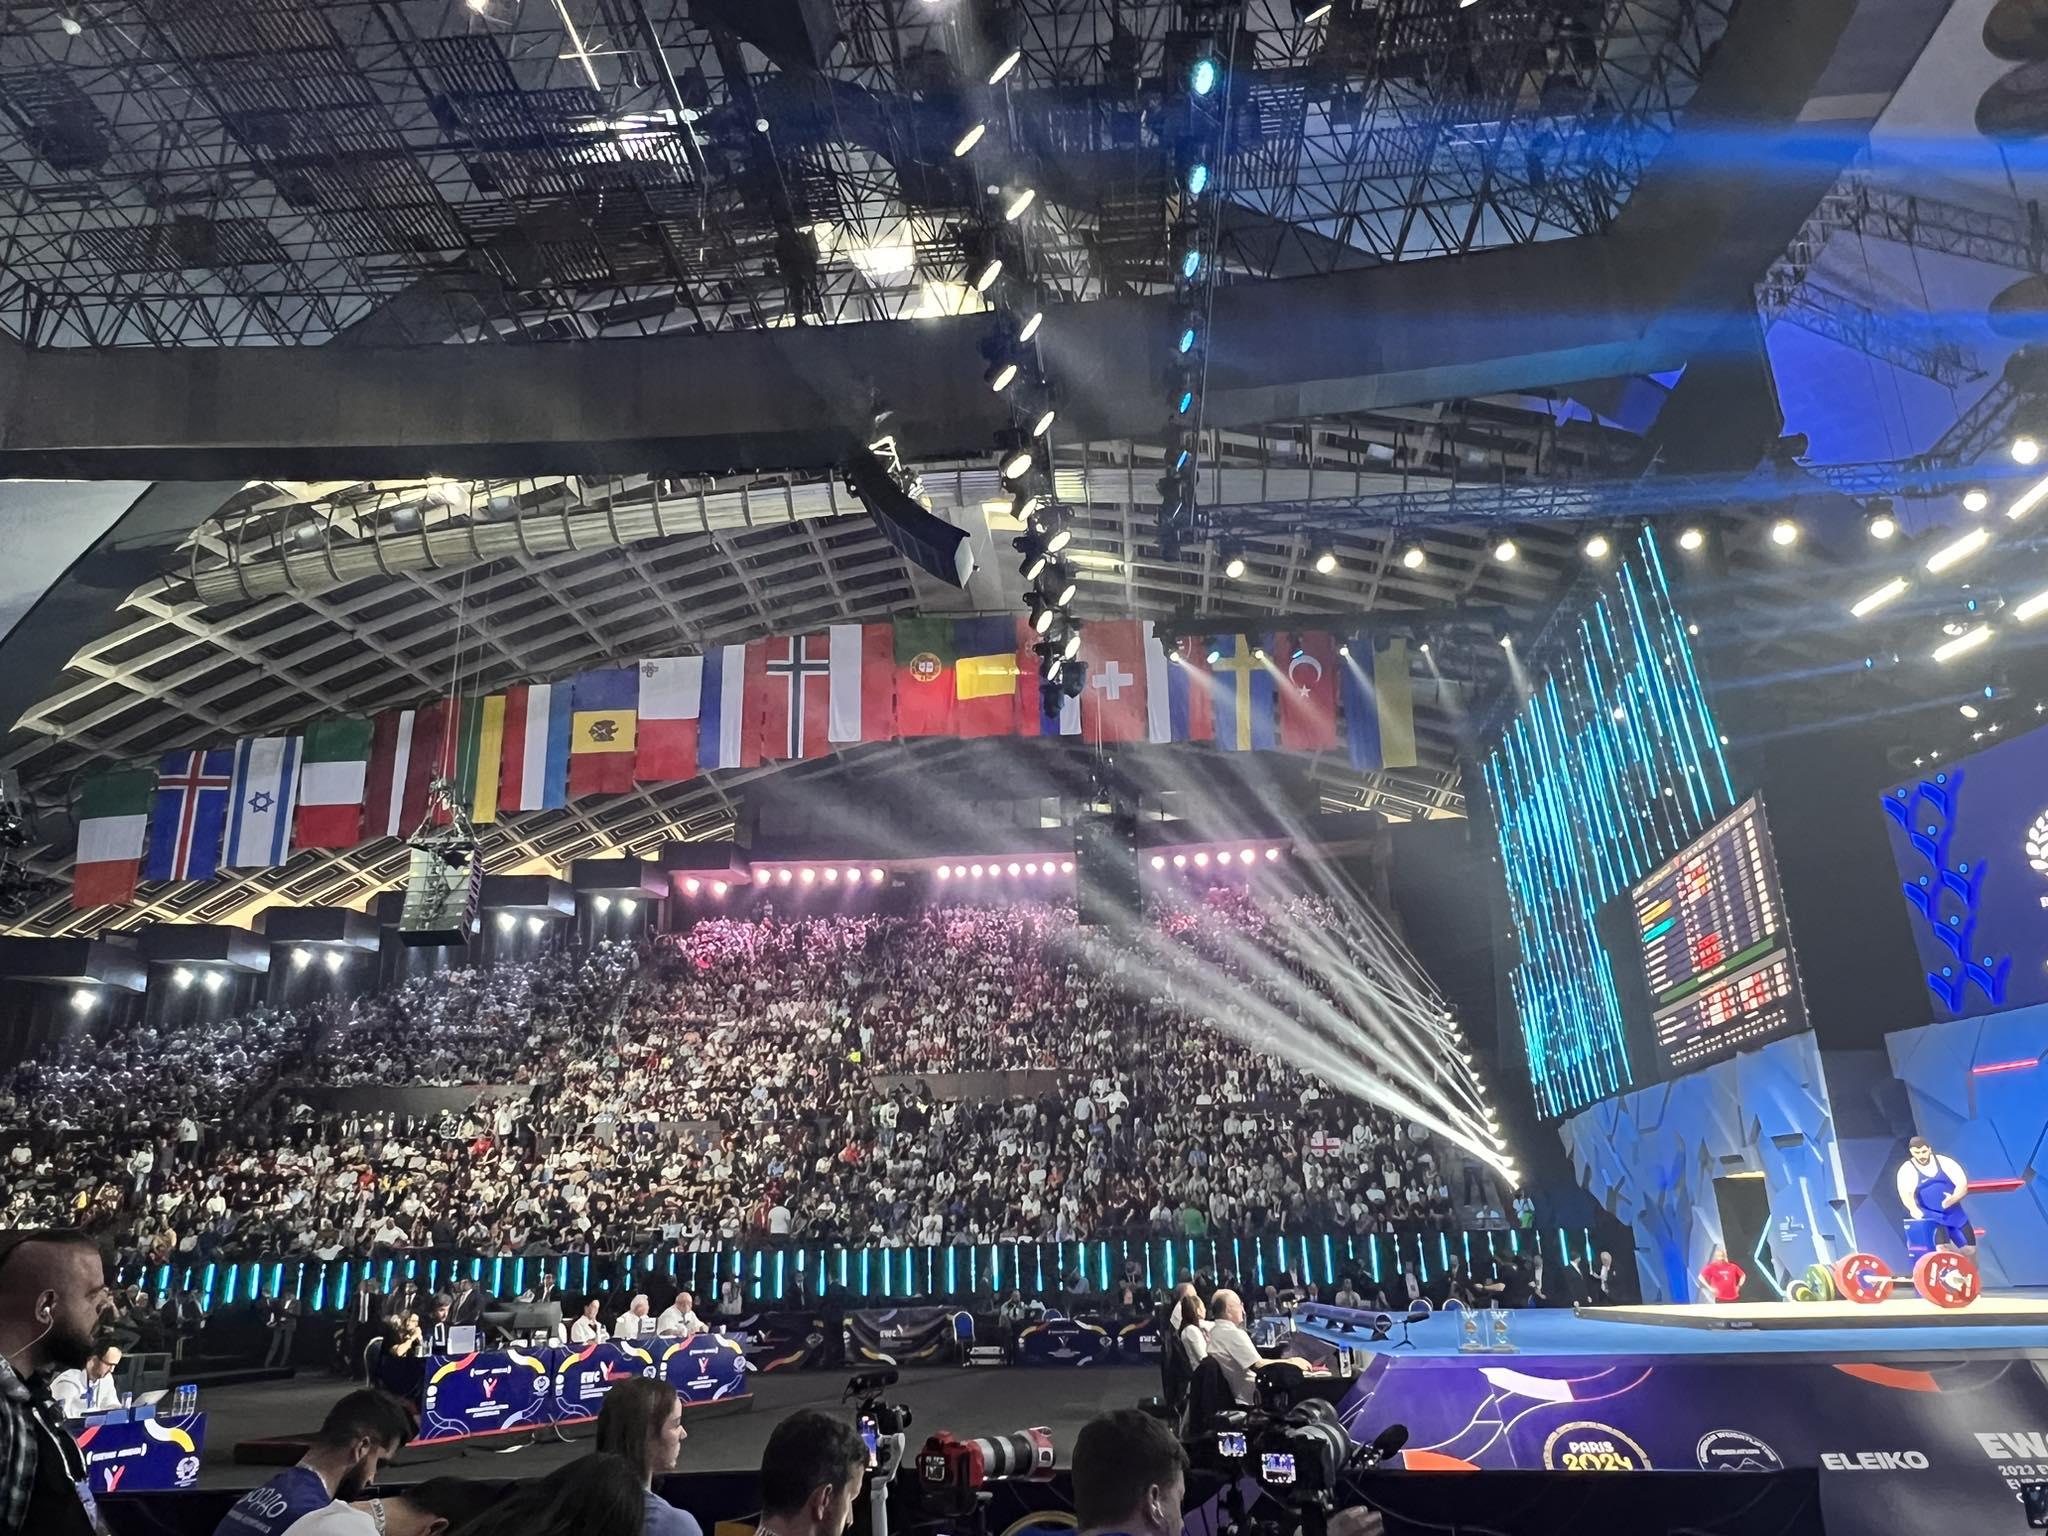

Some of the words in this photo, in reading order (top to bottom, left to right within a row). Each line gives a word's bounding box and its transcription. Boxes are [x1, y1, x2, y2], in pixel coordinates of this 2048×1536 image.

[1568, 1441, 1615, 1454] PARIS
[1974, 1431, 2048, 1459] EW
[1562, 1453, 1633, 1471] 2024
[1820, 1451, 1930, 1470] ELEIKO
